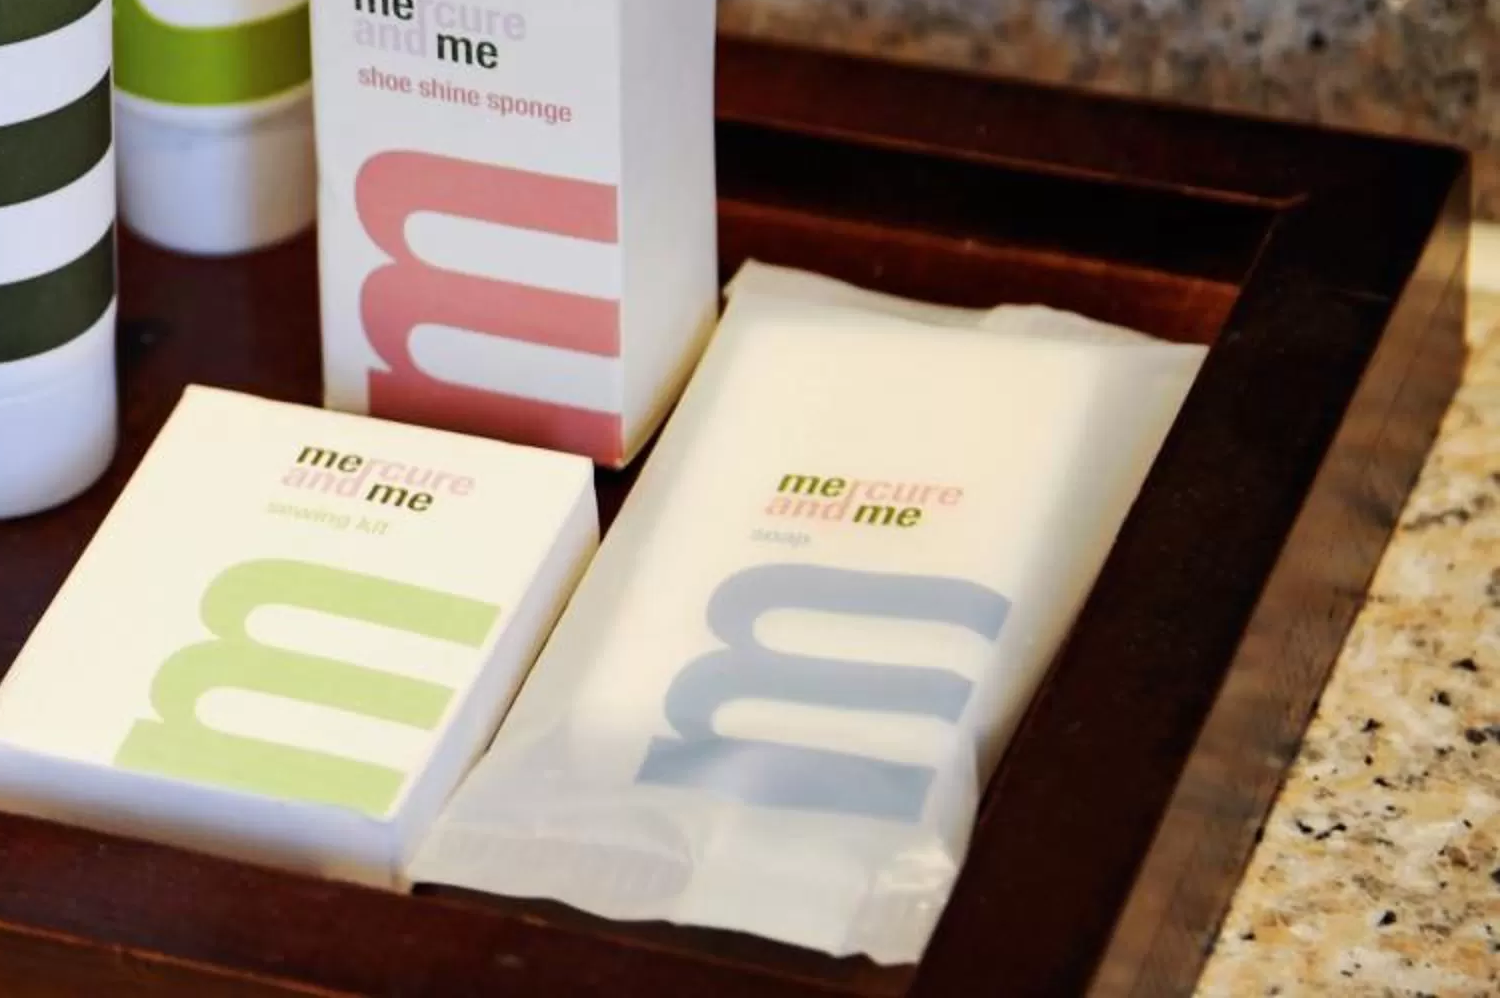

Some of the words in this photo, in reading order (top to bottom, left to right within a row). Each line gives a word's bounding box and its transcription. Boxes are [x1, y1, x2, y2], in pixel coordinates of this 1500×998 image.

[354, 16, 427, 58] and
[436, 32, 498, 69] me
[357, 65, 413, 94] shoe
[418, 78, 481, 107] shine
[486, 90, 573, 125] sponge
[280, 466, 366, 498] and
[365, 482, 435, 512] me
[296, 445, 476, 496] mercure
[777, 472, 964, 506] mercure
[764, 497, 849, 521] and
[853, 504, 922, 527] me
